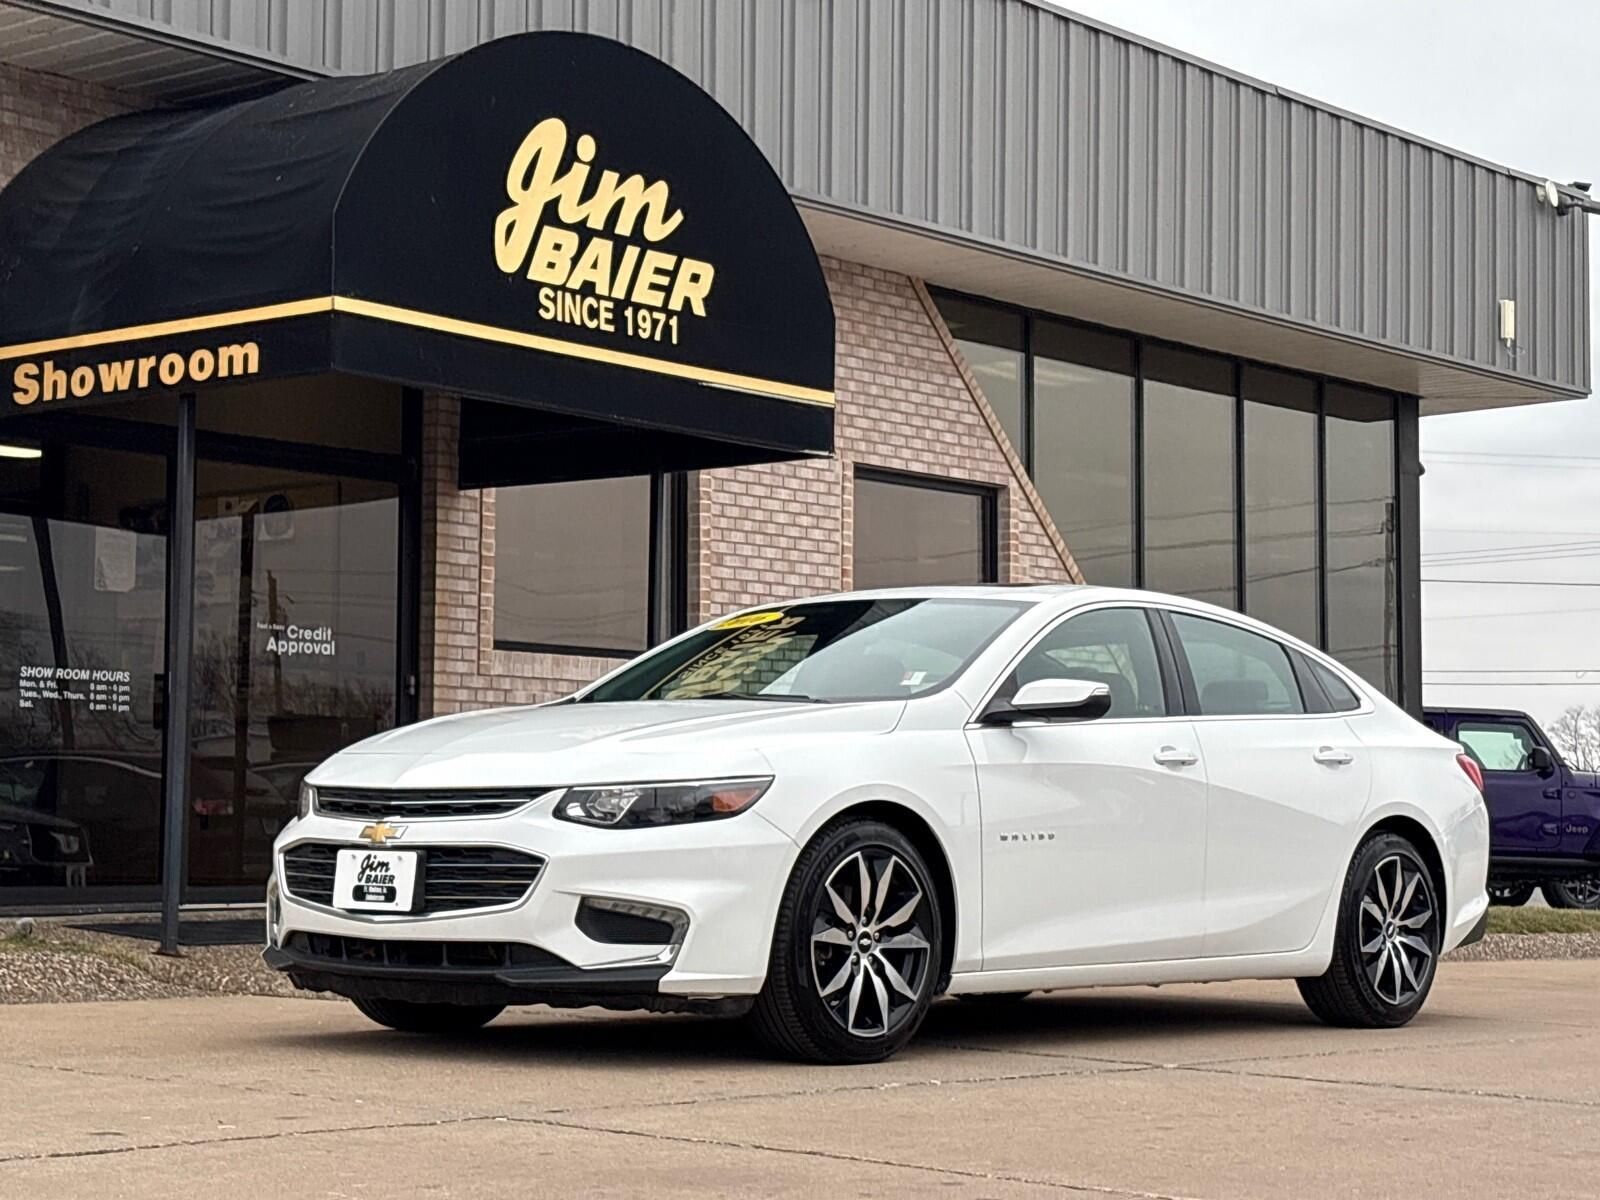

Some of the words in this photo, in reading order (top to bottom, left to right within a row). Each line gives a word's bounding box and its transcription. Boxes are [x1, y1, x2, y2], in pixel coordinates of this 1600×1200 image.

[494, 117, 684, 274] Jim
[526, 225, 715, 317] BAIER
[538, 287, 615, 332] SINCE
[624, 306, 678, 345] 1971
[12, 341, 260, 405] Showroom
[287, 624, 332, 641] Credit
[266, 635, 335, 657] Approval
[20, 665, 54, 678] SHOW
[56, 667, 90, 680] ROOM
[92, 669, 131, 682] HOURS
[1565, 823, 1589, 835] Jeep
[357, 854, 391, 883] Jim
[365, 874, 396, 885] BAIER
